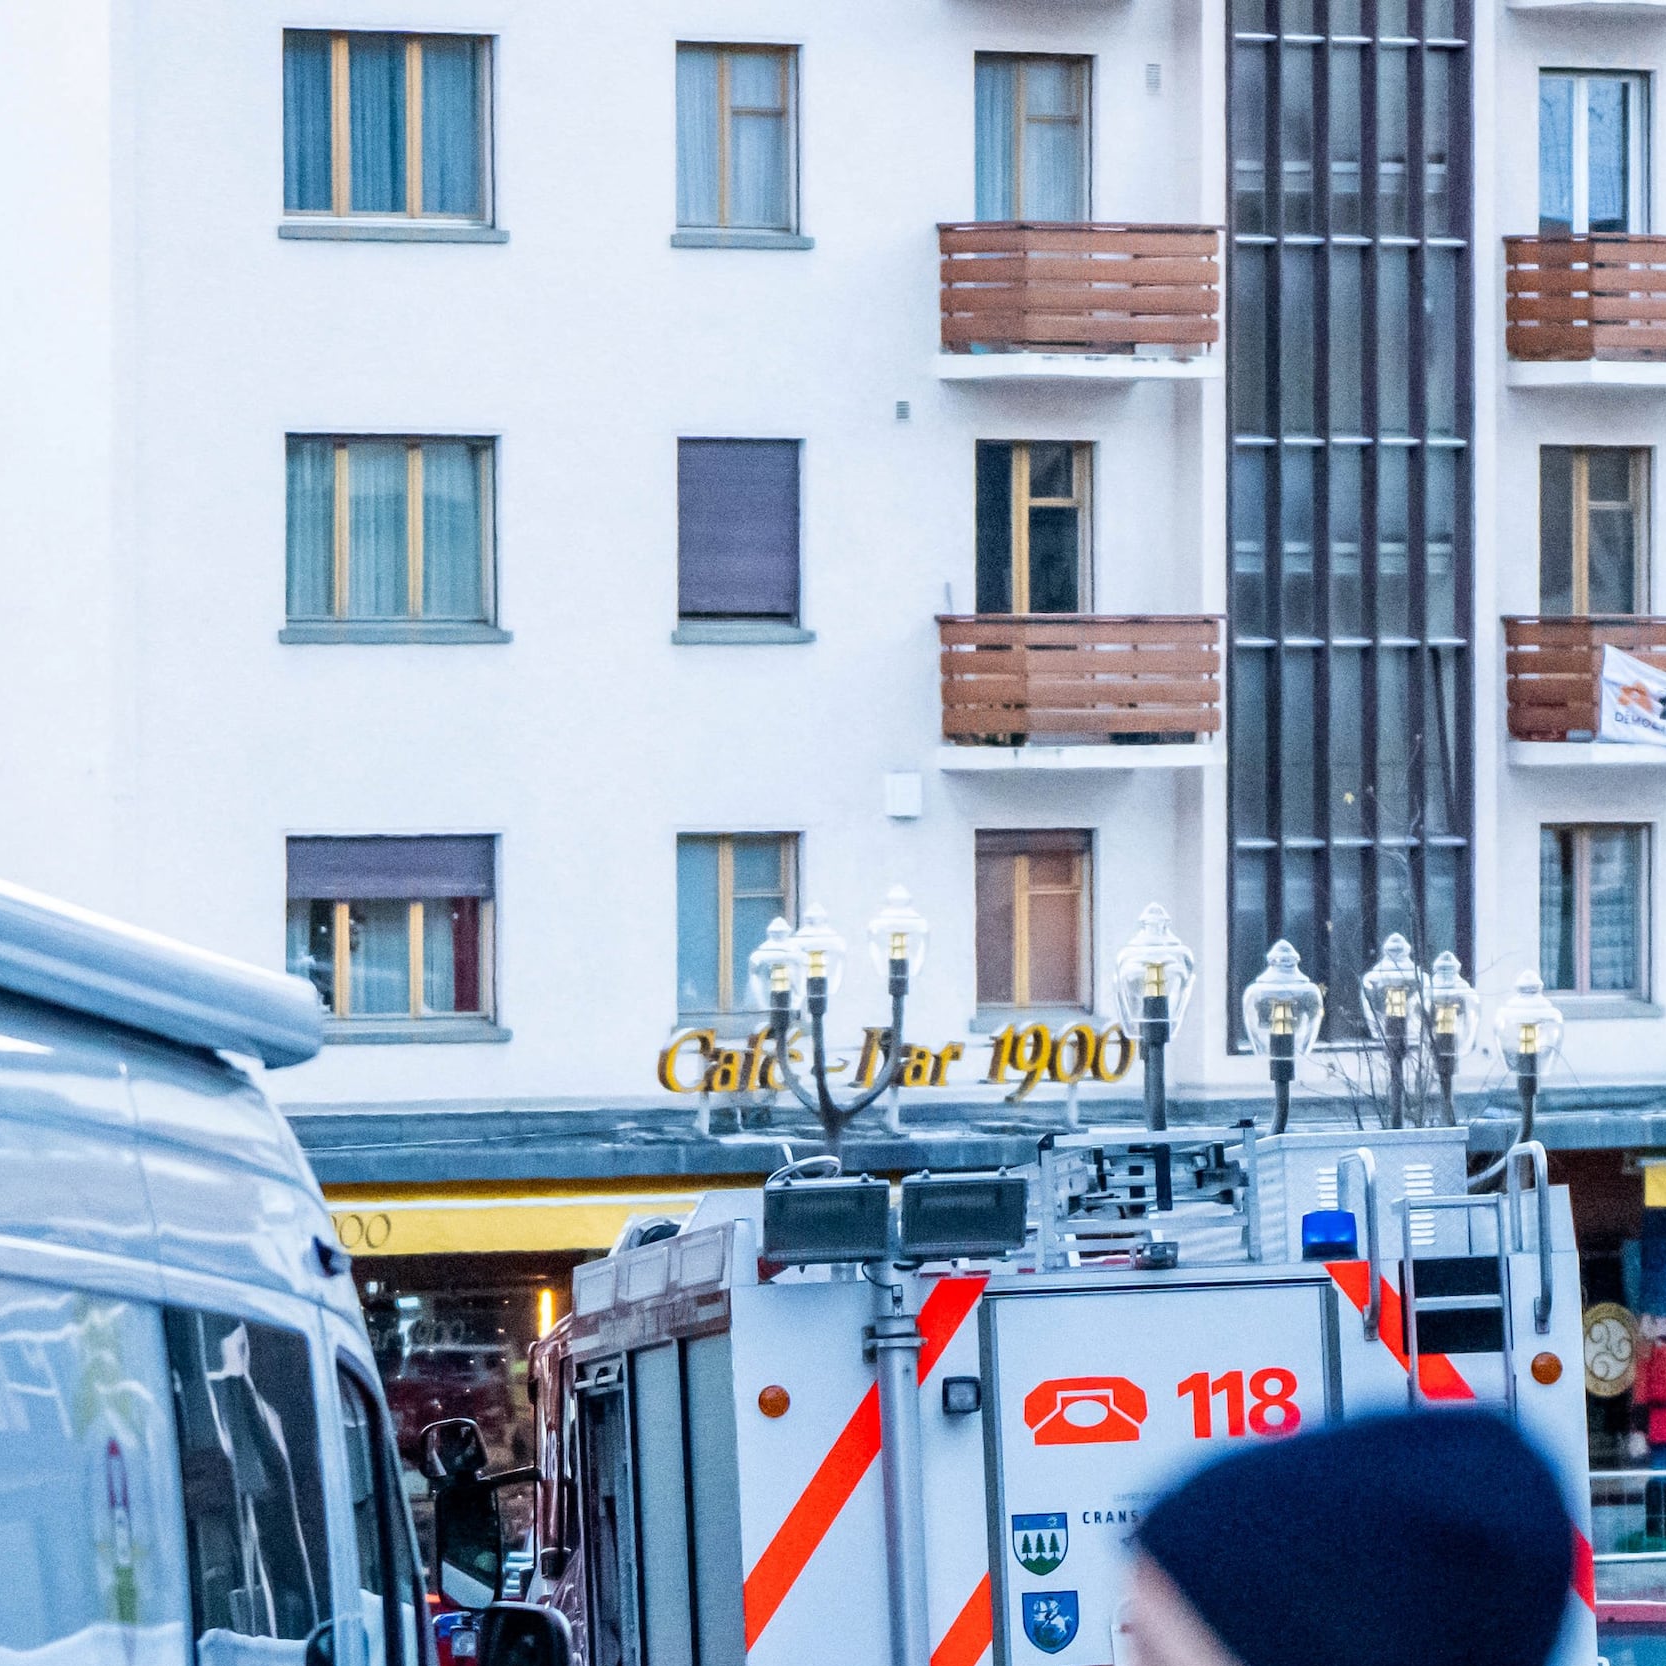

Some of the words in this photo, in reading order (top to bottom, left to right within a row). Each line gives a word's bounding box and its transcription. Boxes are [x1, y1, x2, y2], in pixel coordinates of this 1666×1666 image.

[657, 1023, 803, 1093] Café
[978, 1022, 1136, 1103] 1900
[331, 1213, 391, 1249] 00
[1176, 1367, 1302, 1440] 118
